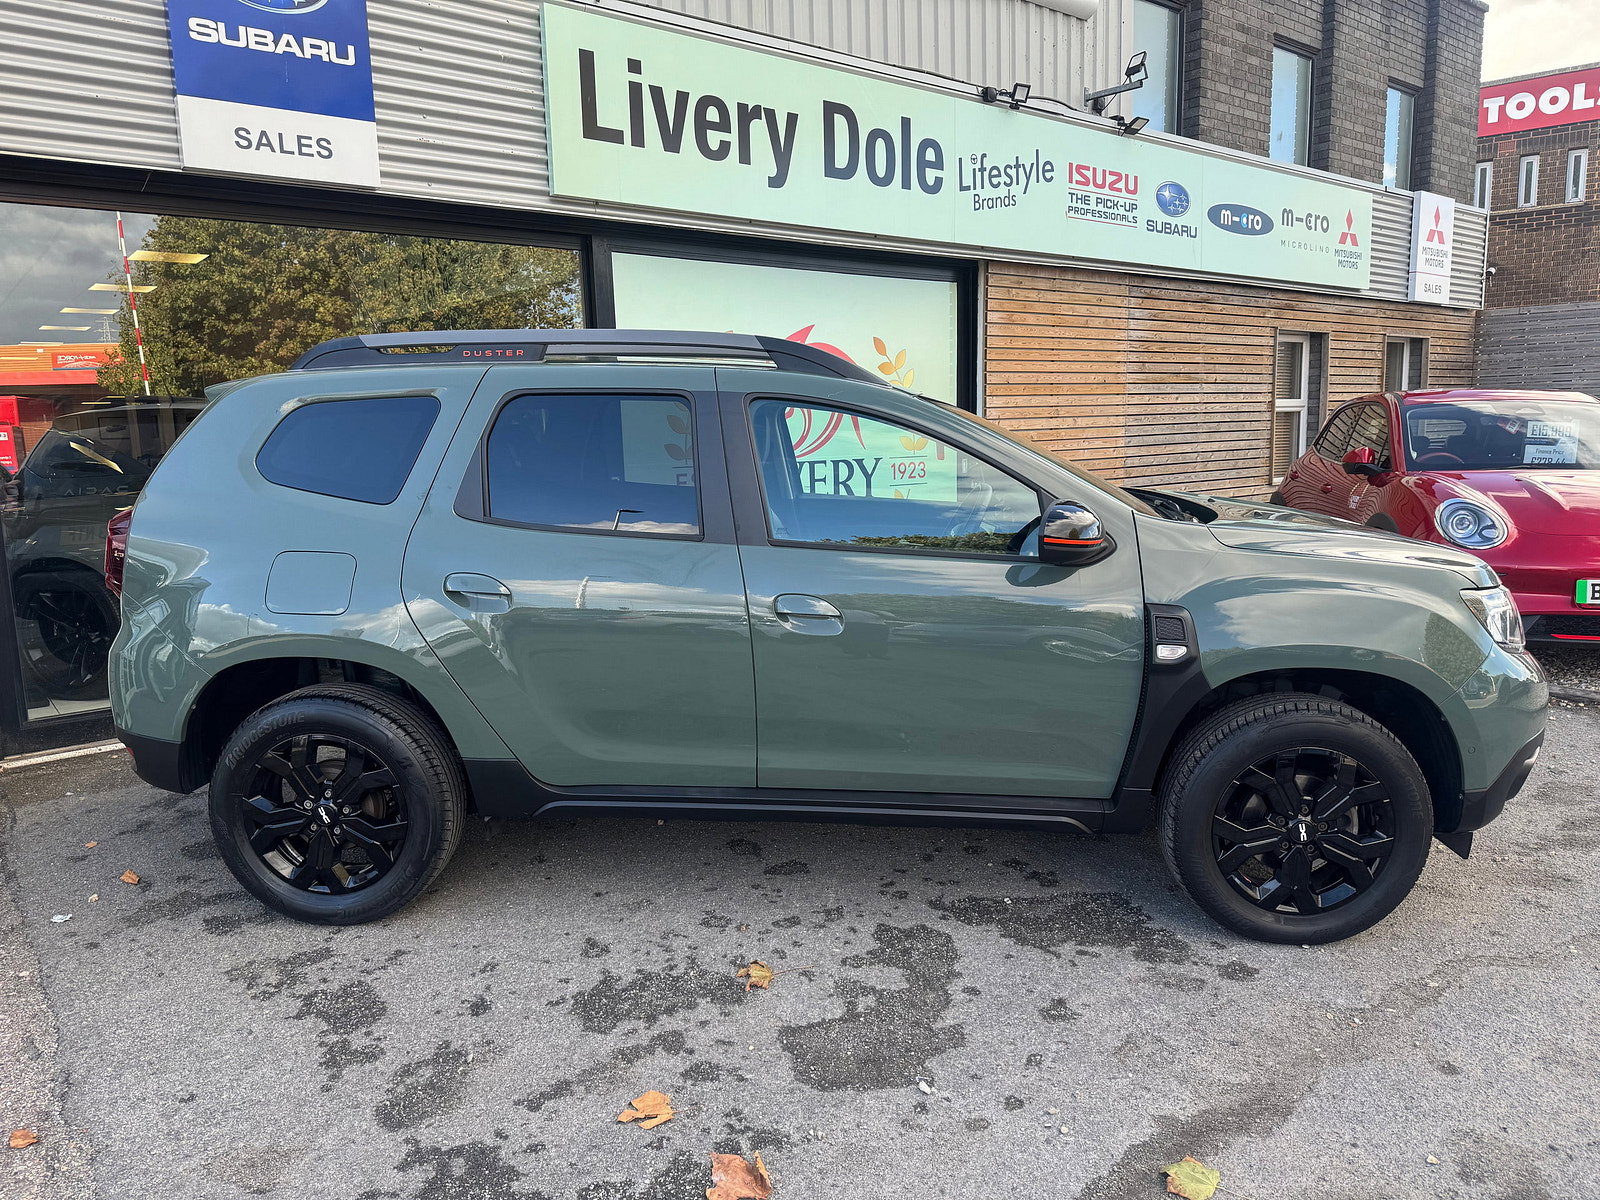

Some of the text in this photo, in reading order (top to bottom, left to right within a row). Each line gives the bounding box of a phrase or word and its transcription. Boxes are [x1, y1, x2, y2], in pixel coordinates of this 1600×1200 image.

[188, 17, 356, 66] SUBARU
[1483, 82, 1600, 124] TOOL
[578, 48, 945, 195] Livery Dole
[234, 126, 333, 160] SALES
[958, 149, 1055, 195] Lifestyle
[1068, 162, 1139, 195] ISUZU
[973, 189, 1017, 212] Brands
[1068, 192, 1138, 213] THE PICK-UP
[1067, 206, 1138, 224] PROFESSIONALS
[1146, 219, 1198, 239] SUBARU
[1281, 240, 1330, 254] MICROLINO
[1334, 248, 1363, 261] MITSUBISHI
[1422, 246, 1449, 259] MITSUBISHI
[1337, 259, 1359, 270] MOTORS
[1424, 257, 1444, 269] MOTORS
[1423, 283, 1442, 295] SALES
[463, 349, 524, 357] DUSTER
[890, 461, 927, 481] 1923
